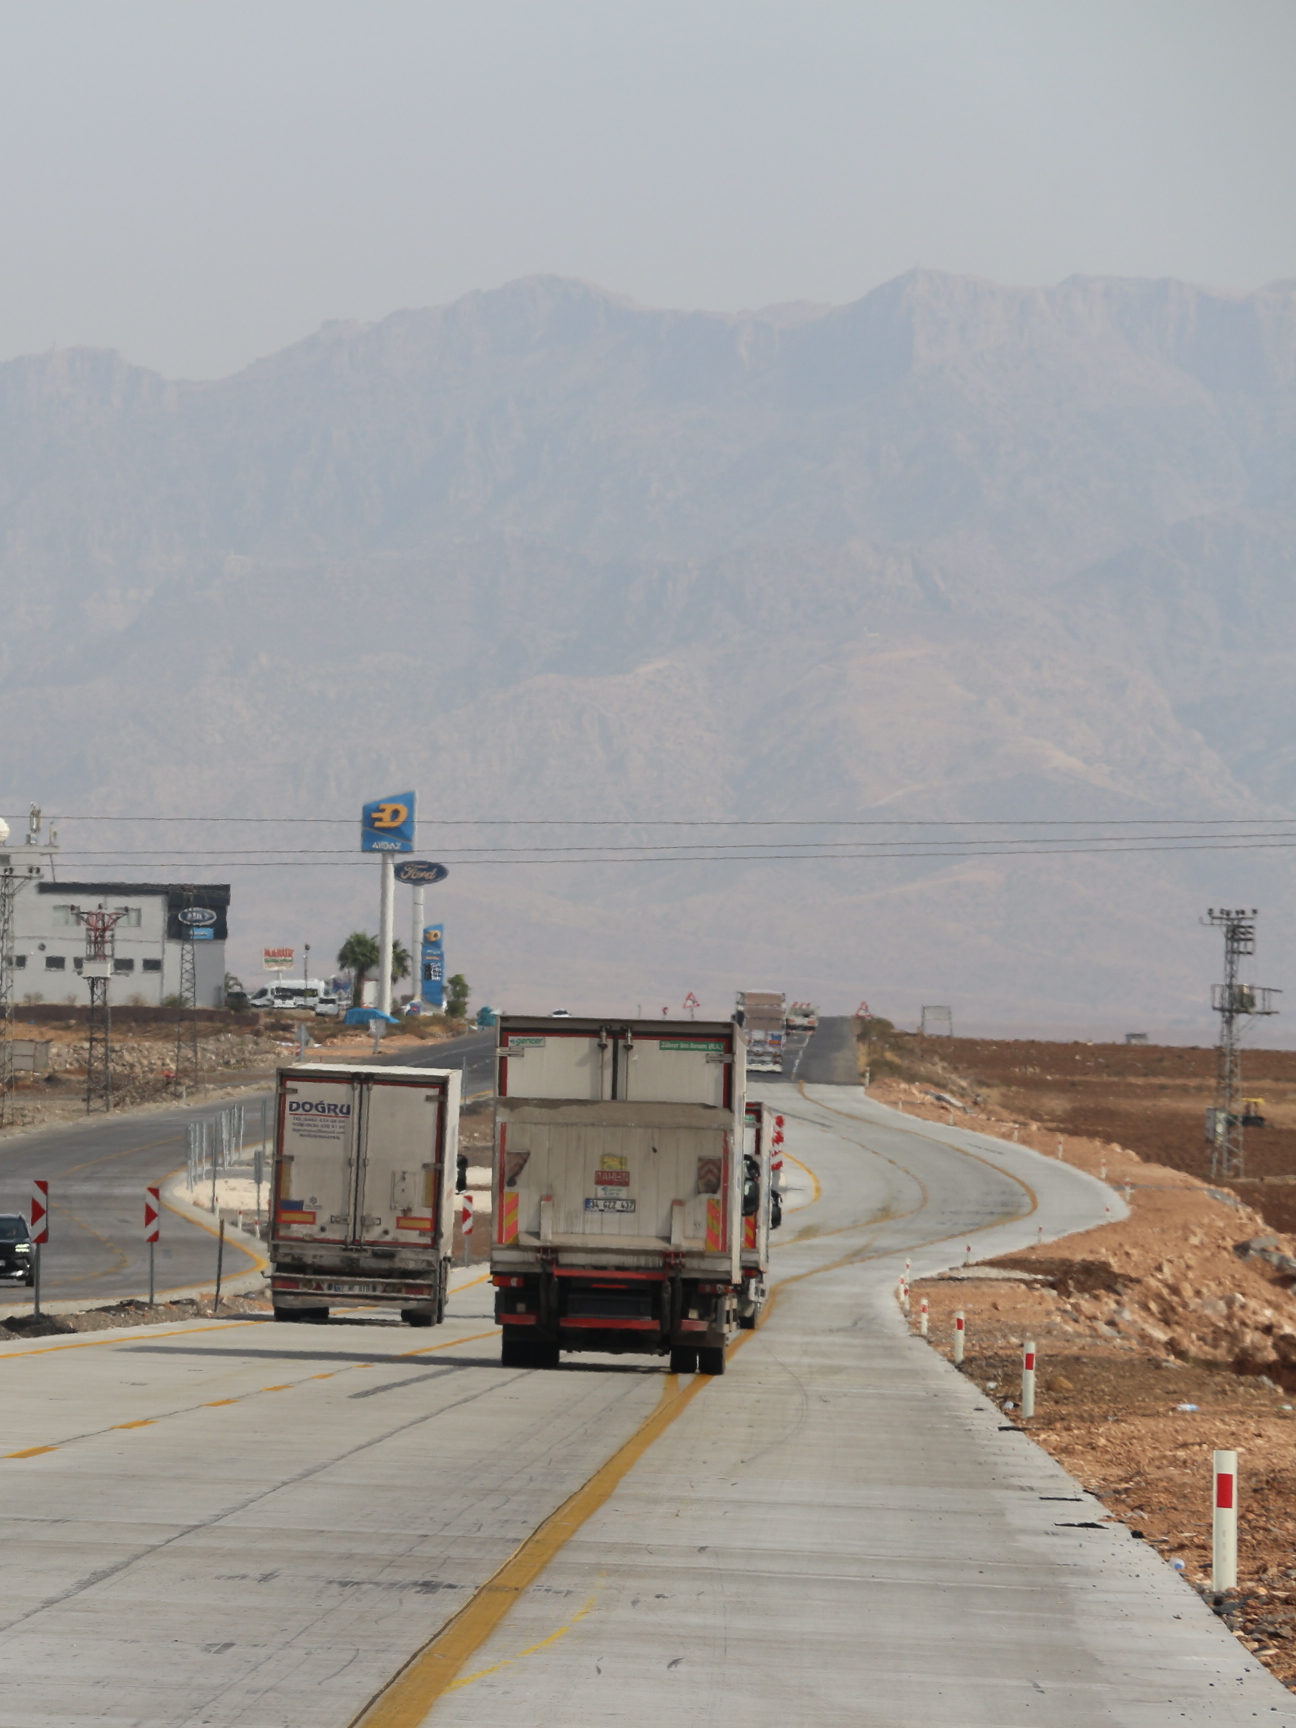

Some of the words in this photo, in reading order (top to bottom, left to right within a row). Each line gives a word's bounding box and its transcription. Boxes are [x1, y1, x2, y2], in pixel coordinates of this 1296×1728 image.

[401, 863, 437, 879] Ford
[289, 1100, 351, 1115] DOĞRU
[590, 1200, 599, 1208] 34
